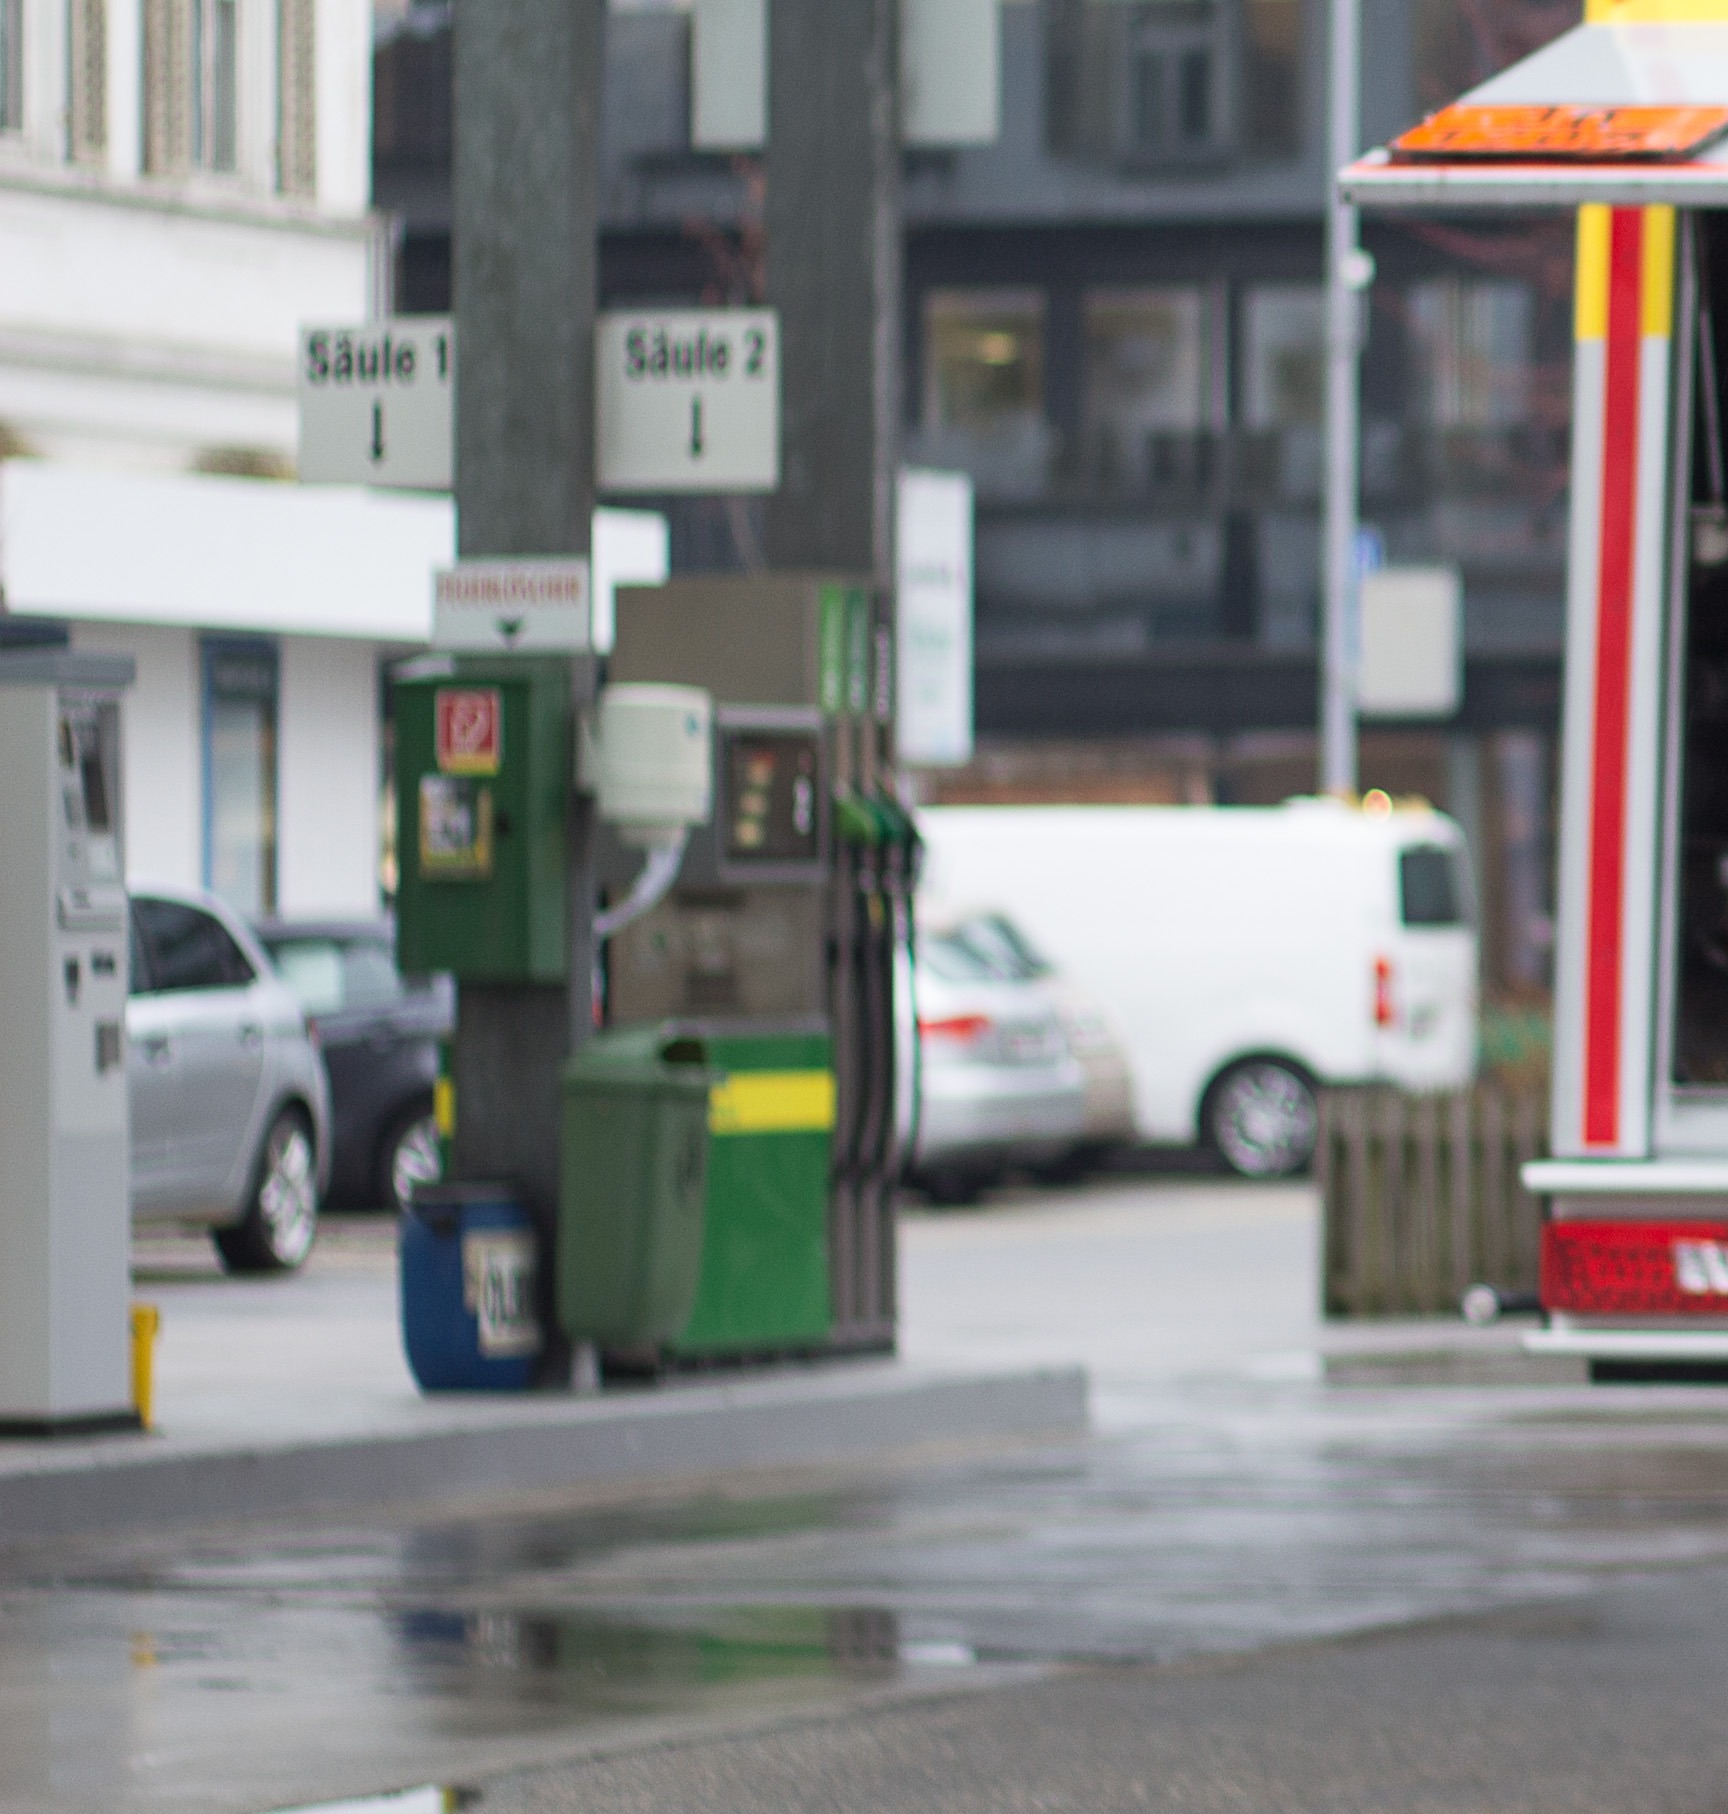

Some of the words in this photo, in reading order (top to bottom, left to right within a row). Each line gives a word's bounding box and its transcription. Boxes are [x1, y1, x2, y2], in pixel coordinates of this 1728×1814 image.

[308, 329, 415, 383] Säule
[436, 333, 447, 381] 1
[625, 327, 731, 379] Säule
[745, 328, 765, 377] 2
